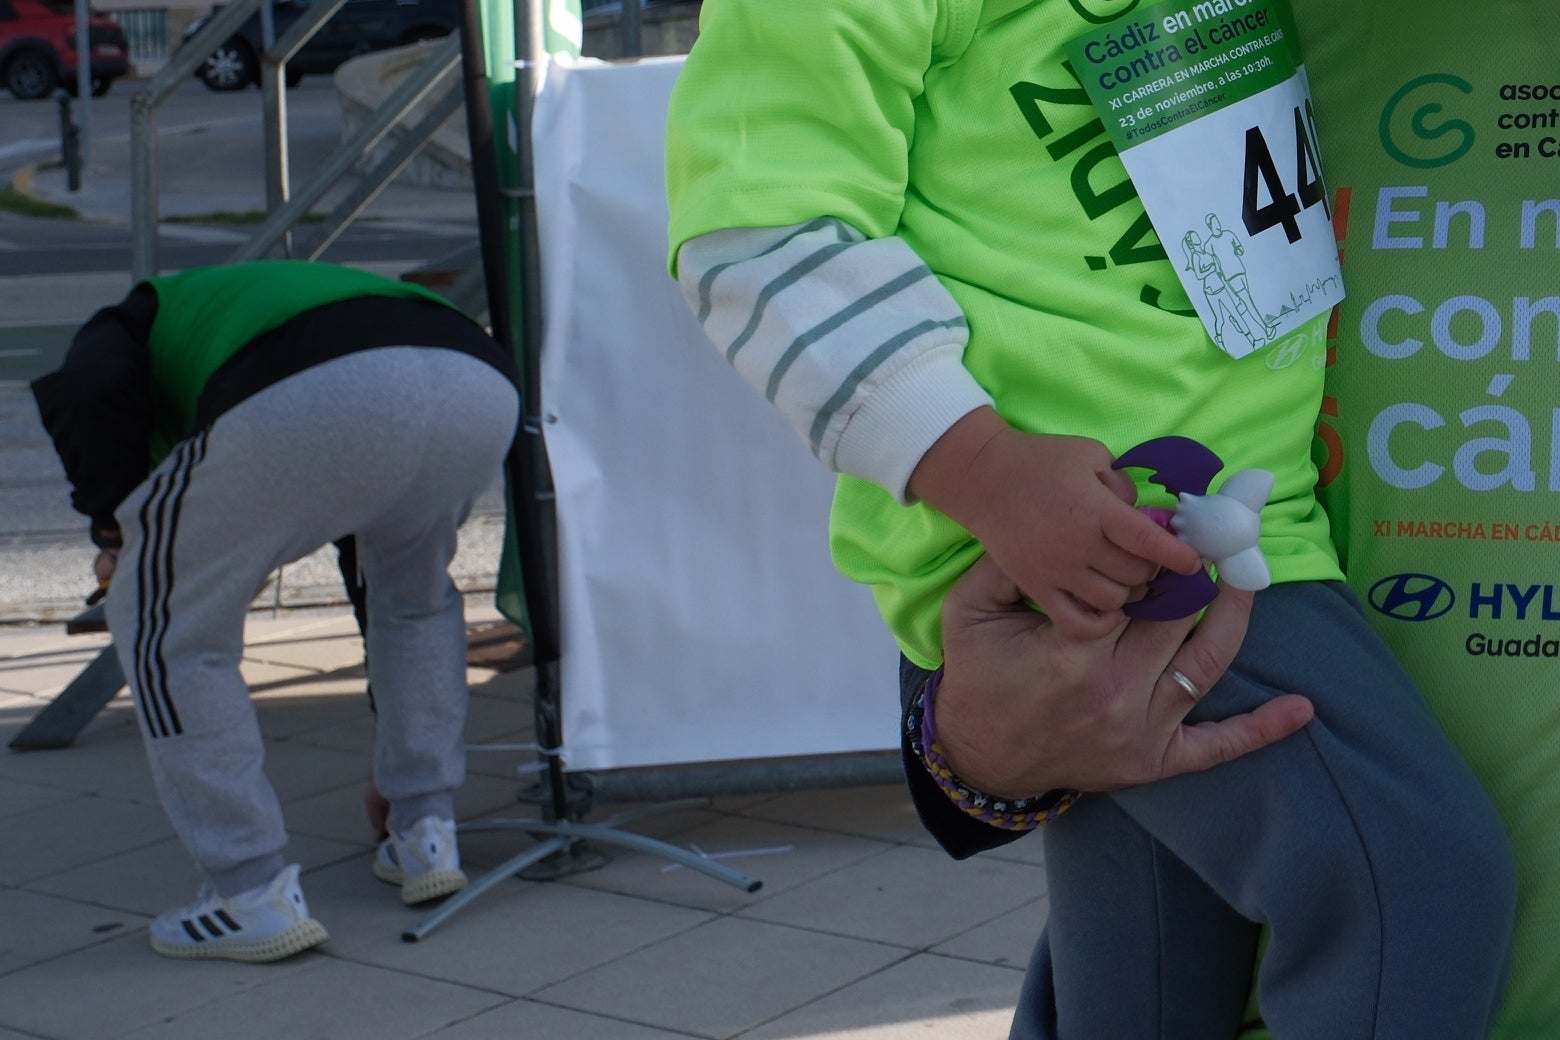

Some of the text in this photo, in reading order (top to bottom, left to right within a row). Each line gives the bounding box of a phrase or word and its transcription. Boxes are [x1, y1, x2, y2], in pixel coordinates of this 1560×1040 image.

[1084, 21, 1160, 64] Cádiz
[1162, 10, 1192, 34] en
[1098, 7, 1270, 90] contra el cáncer
[1108, 96, 1123, 110] XI
[1123, 76, 1175, 105] CARRERA
[1175, 67, 1191, 83] EN
[1190, 53, 1230, 78] MARCHA
[1229, 39, 1266, 60] CONTRA
[1118, 114, 1136, 128] 23
[1136, 106, 1153, 121] de
[1155, 80, 1218, 114] noviembre,
[1218, 76, 1227, 87] a
[1225, 69, 1242, 82] las
[1495, 139, 1531, 159] en
[1371, 185, 1487, 250] En
[1373, 519, 1392, 538] XI
[1397, 520, 1487, 540] MARCHA
[1491, 522, 1519, 540] EN
